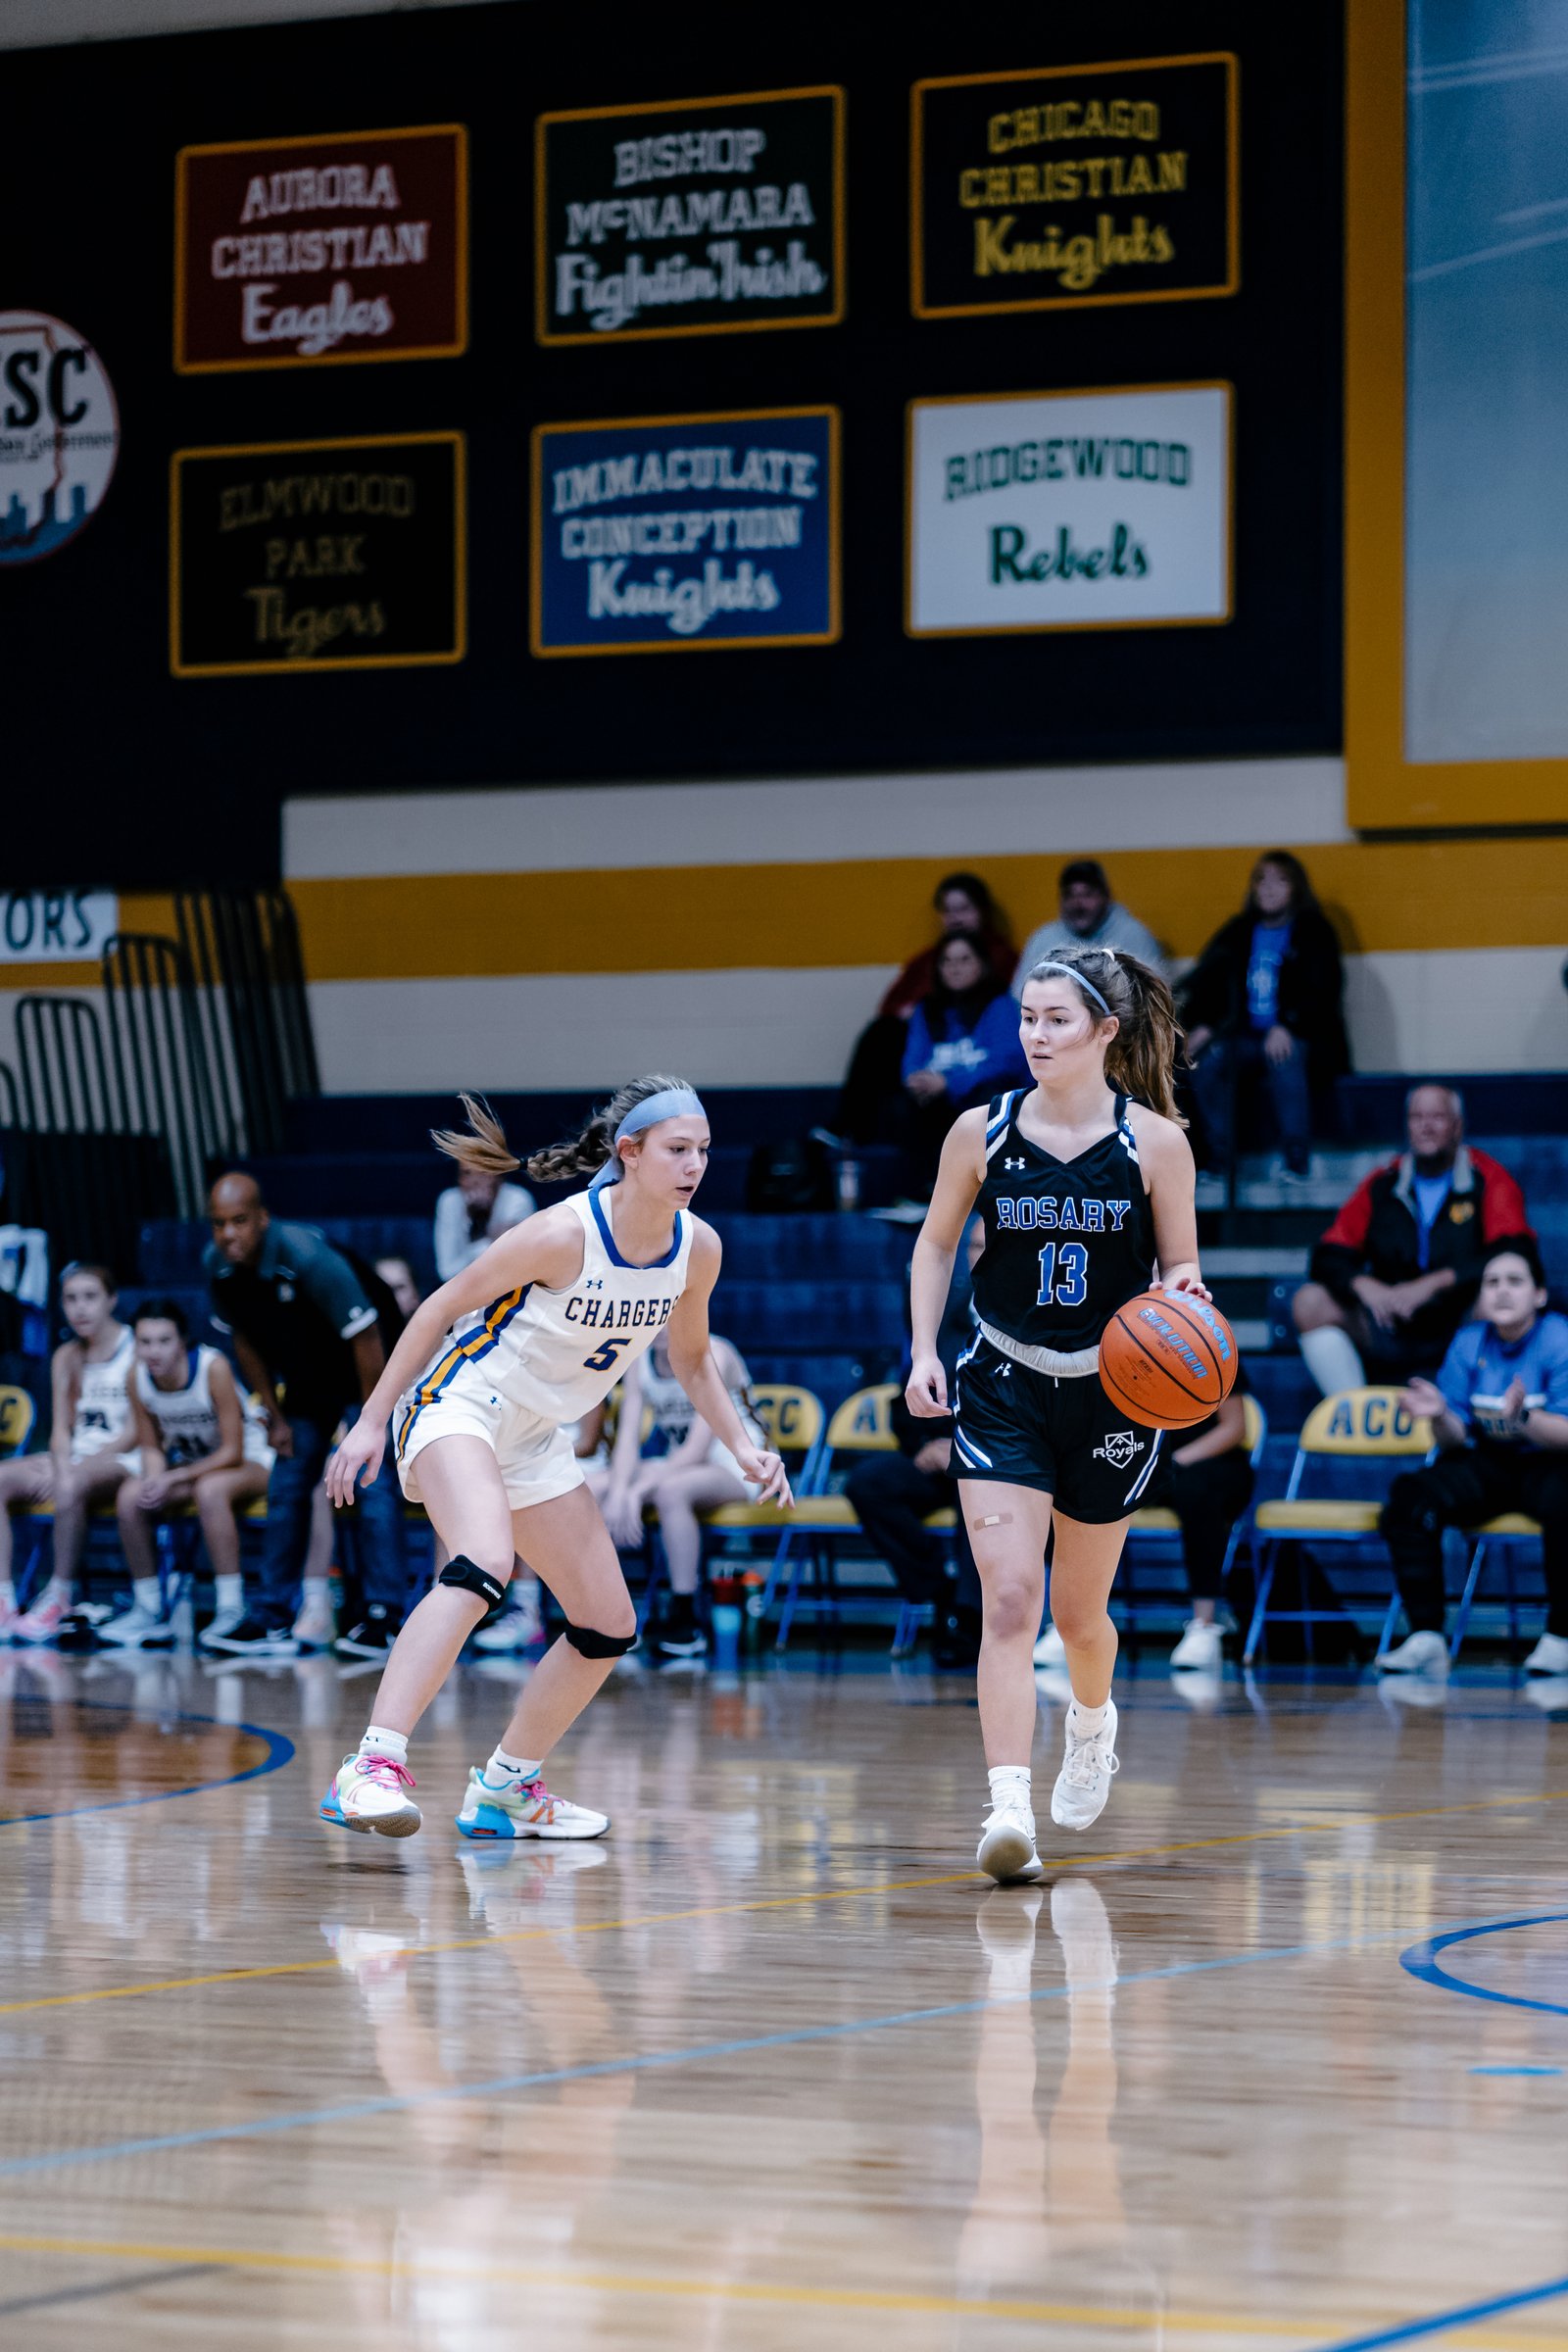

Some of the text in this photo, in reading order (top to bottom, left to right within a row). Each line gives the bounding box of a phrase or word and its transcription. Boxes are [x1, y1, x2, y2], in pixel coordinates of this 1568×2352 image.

[989, 100, 1158, 153] CHICAGO
[613, 128, 766, 187] BISHOP
[959, 151, 1187, 209] CHRISTIAN
[241, 164, 399, 222] AURORA
[212, 222, 430, 278] CHRISTIAN
[974, 214, 1174, 289] Knights
[242, 281, 393, 356] Eagles
[4, 349, 88, 427] SC
[553, 448, 817, 514] IMMACULATE
[944, 438, 1191, 501] RIDGEWOOD
[220, 473, 416, 532] ELMWOOD
[265, 533, 368, 580] PARK
[561, 506, 802, 559] CONCEPTION
[990, 523, 1150, 586] Rebels
[243, 585, 388, 659] Tigers
[587, 561, 780, 636] Knights
[996, 1197, 1131, 1232] ROSARY
[1037, 1243, 1088, 1305] 13
[583, 1338, 633, 1371] 5
[1138, 1307, 1208, 1379] EVOLUTION
[1093, 1442, 1145, 1459] Royals
